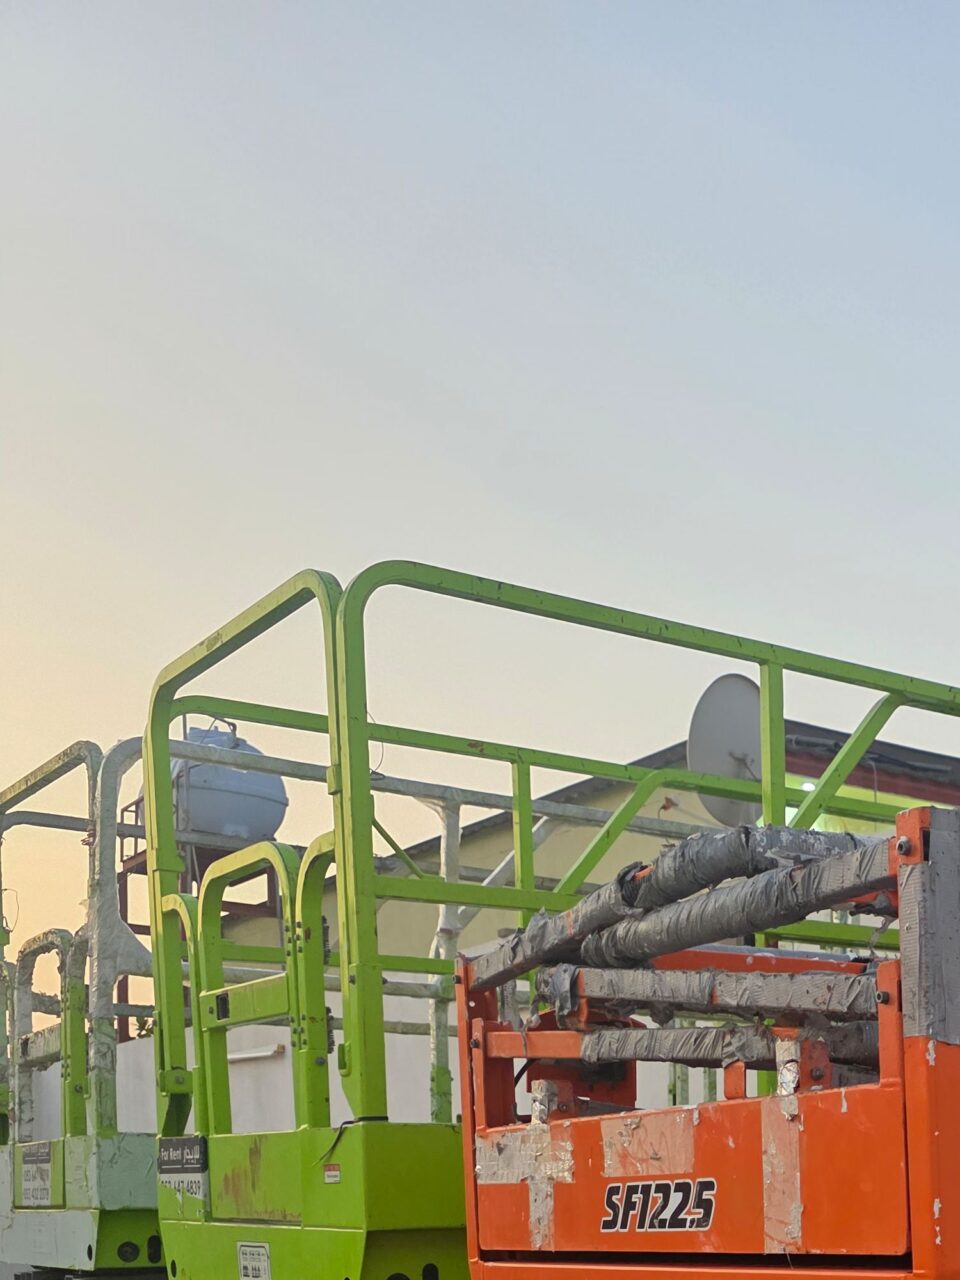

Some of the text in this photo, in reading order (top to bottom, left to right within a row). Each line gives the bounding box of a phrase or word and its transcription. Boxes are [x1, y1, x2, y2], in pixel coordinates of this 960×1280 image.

[160, 1147, 182, 1161] For Rent
[600, 1178, 717, 1232] SF1225
